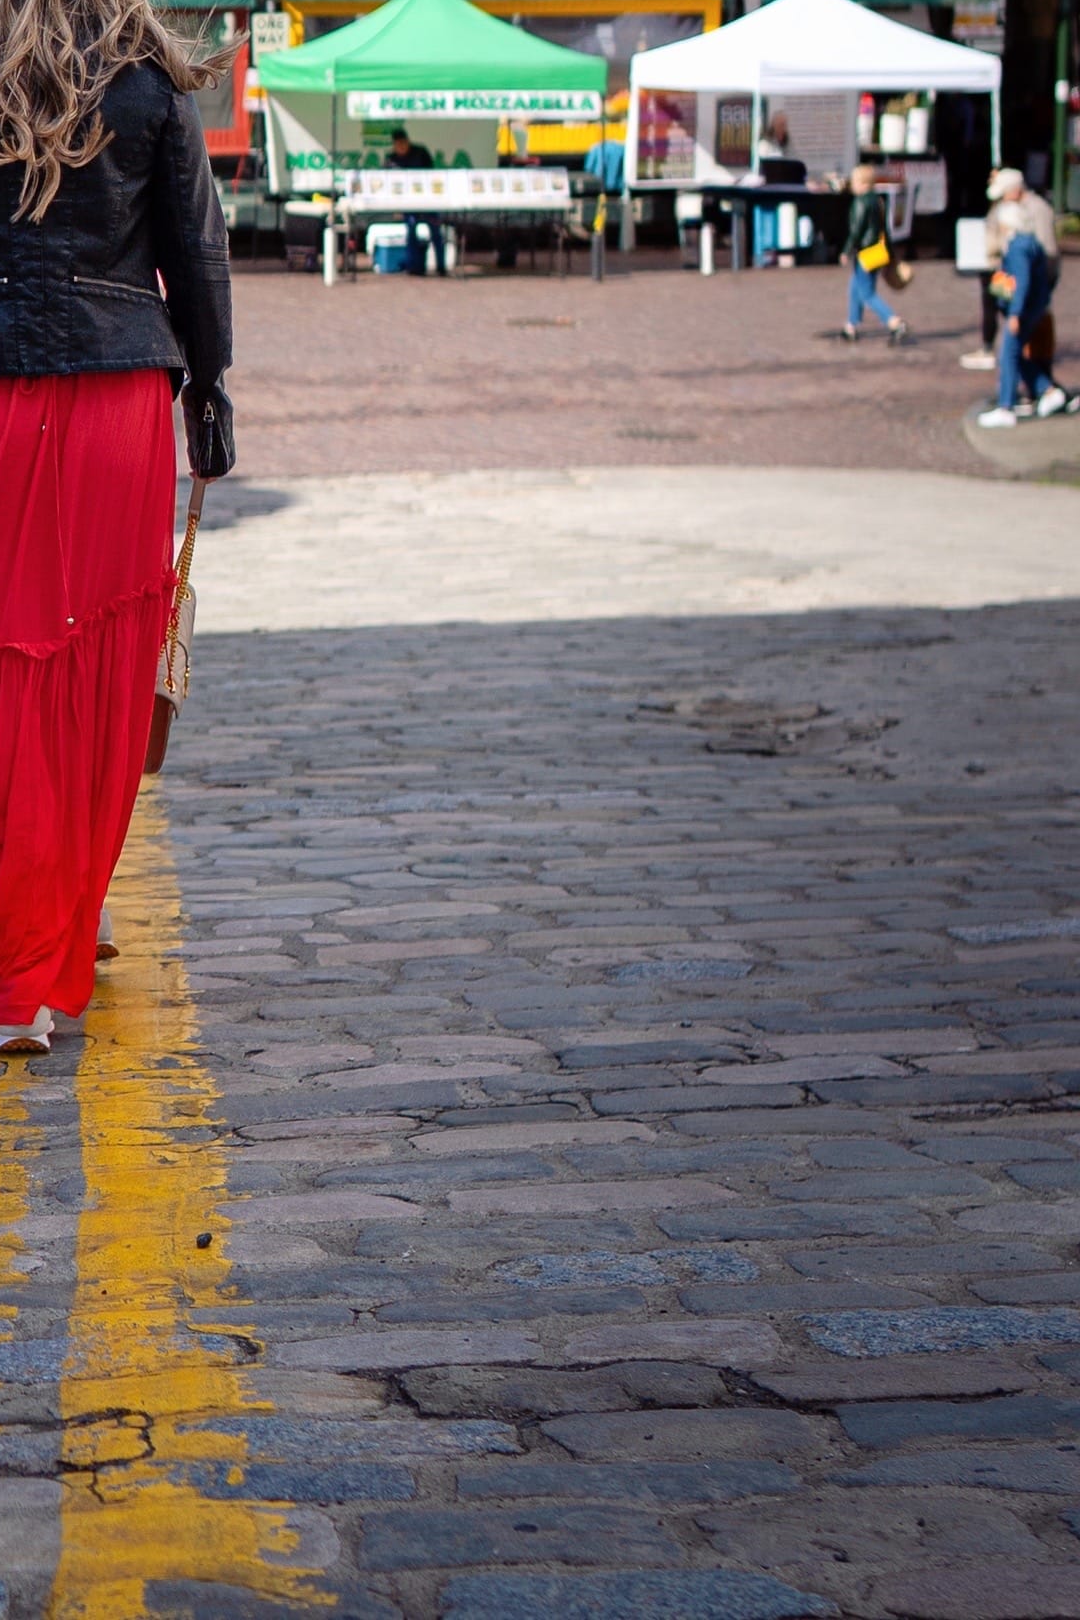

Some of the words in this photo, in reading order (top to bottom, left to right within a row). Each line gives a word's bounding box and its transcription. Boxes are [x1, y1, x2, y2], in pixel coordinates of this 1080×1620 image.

[256, 16, 284, 29] ONE
[257, 31, 284, 45] WAY
[378, 95, 447, 112] FRESH
[454, 94, 595, 112] MOZZARELLA
[284, 149, 474, 171] MOZZALA
